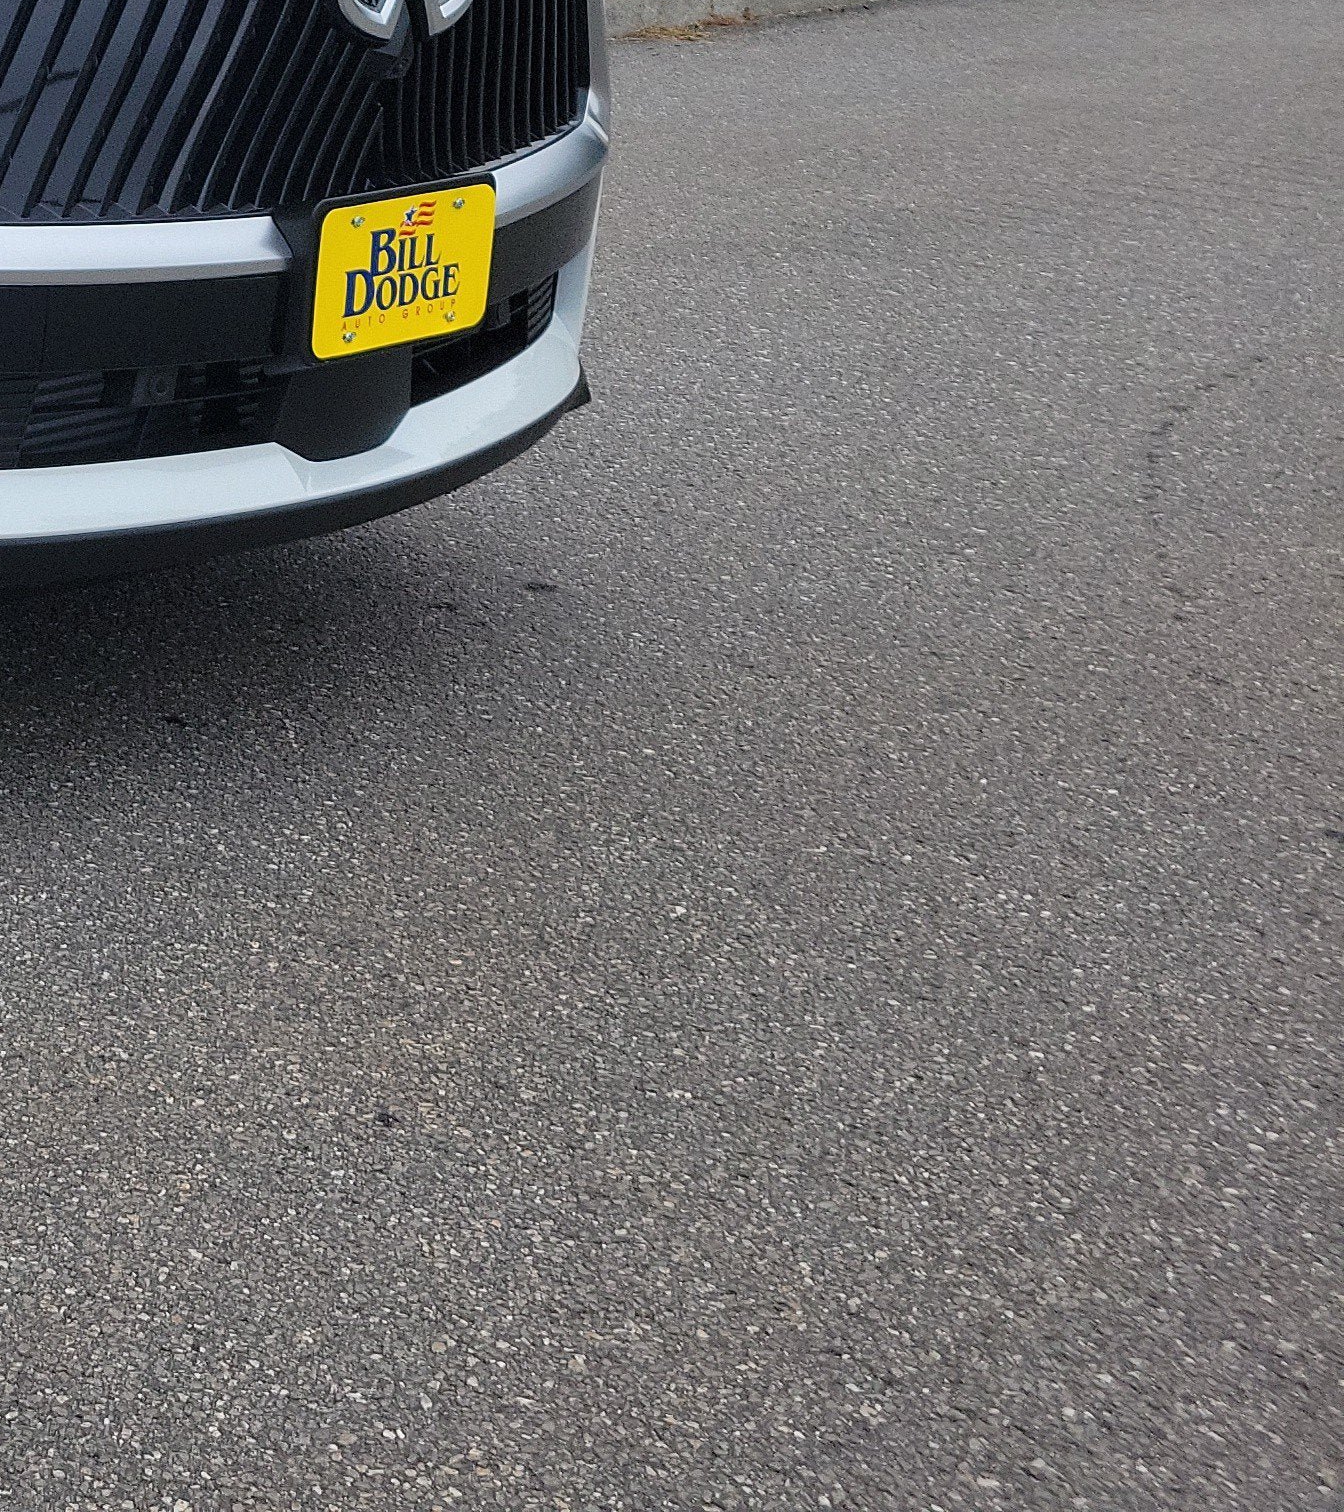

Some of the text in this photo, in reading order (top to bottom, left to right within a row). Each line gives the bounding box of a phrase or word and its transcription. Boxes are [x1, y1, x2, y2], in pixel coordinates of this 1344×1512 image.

[370, 227, 442, 277] BILL
[341, 262, 461, 319] DODGE
[341, 299, 457, 332] AUTO GROUP
